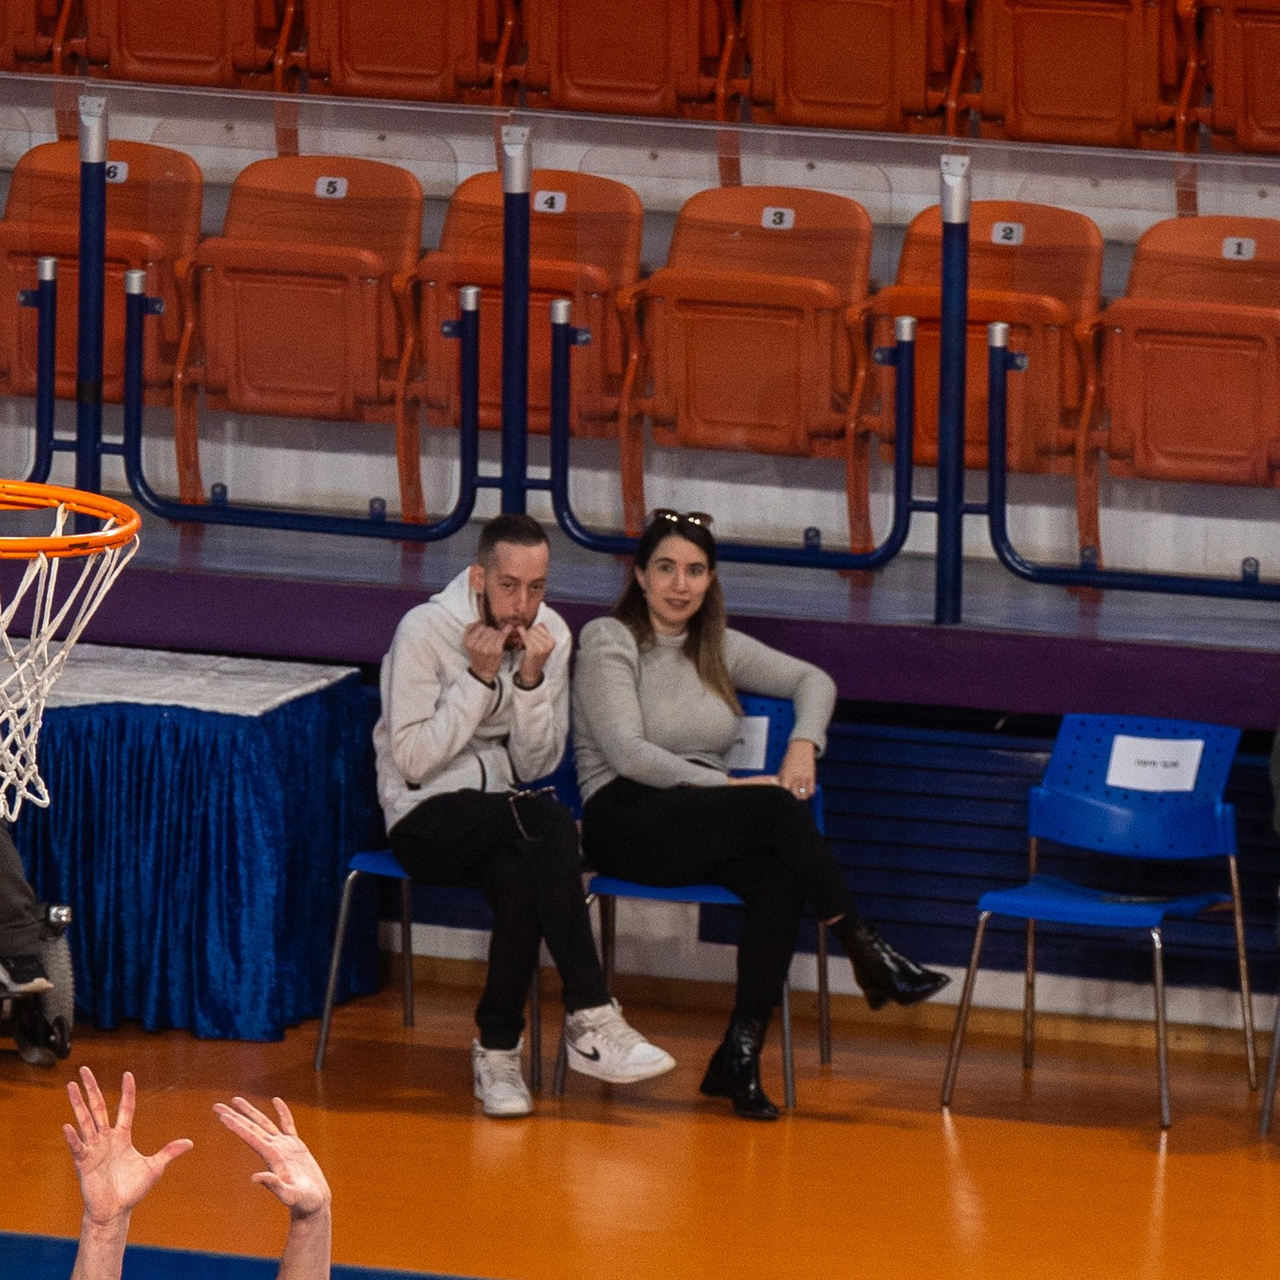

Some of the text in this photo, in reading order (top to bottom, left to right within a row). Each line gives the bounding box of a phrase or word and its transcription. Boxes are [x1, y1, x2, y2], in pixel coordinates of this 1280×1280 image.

[106, 165, 118, 180] 6
[325, 180, 338, 195] 5
[543, 195, 556, 210] 4
[772, 211, 785, 226] 3
[1000, 226, 1014, 241] 2
[1233, 241, 1243, 256] 1
